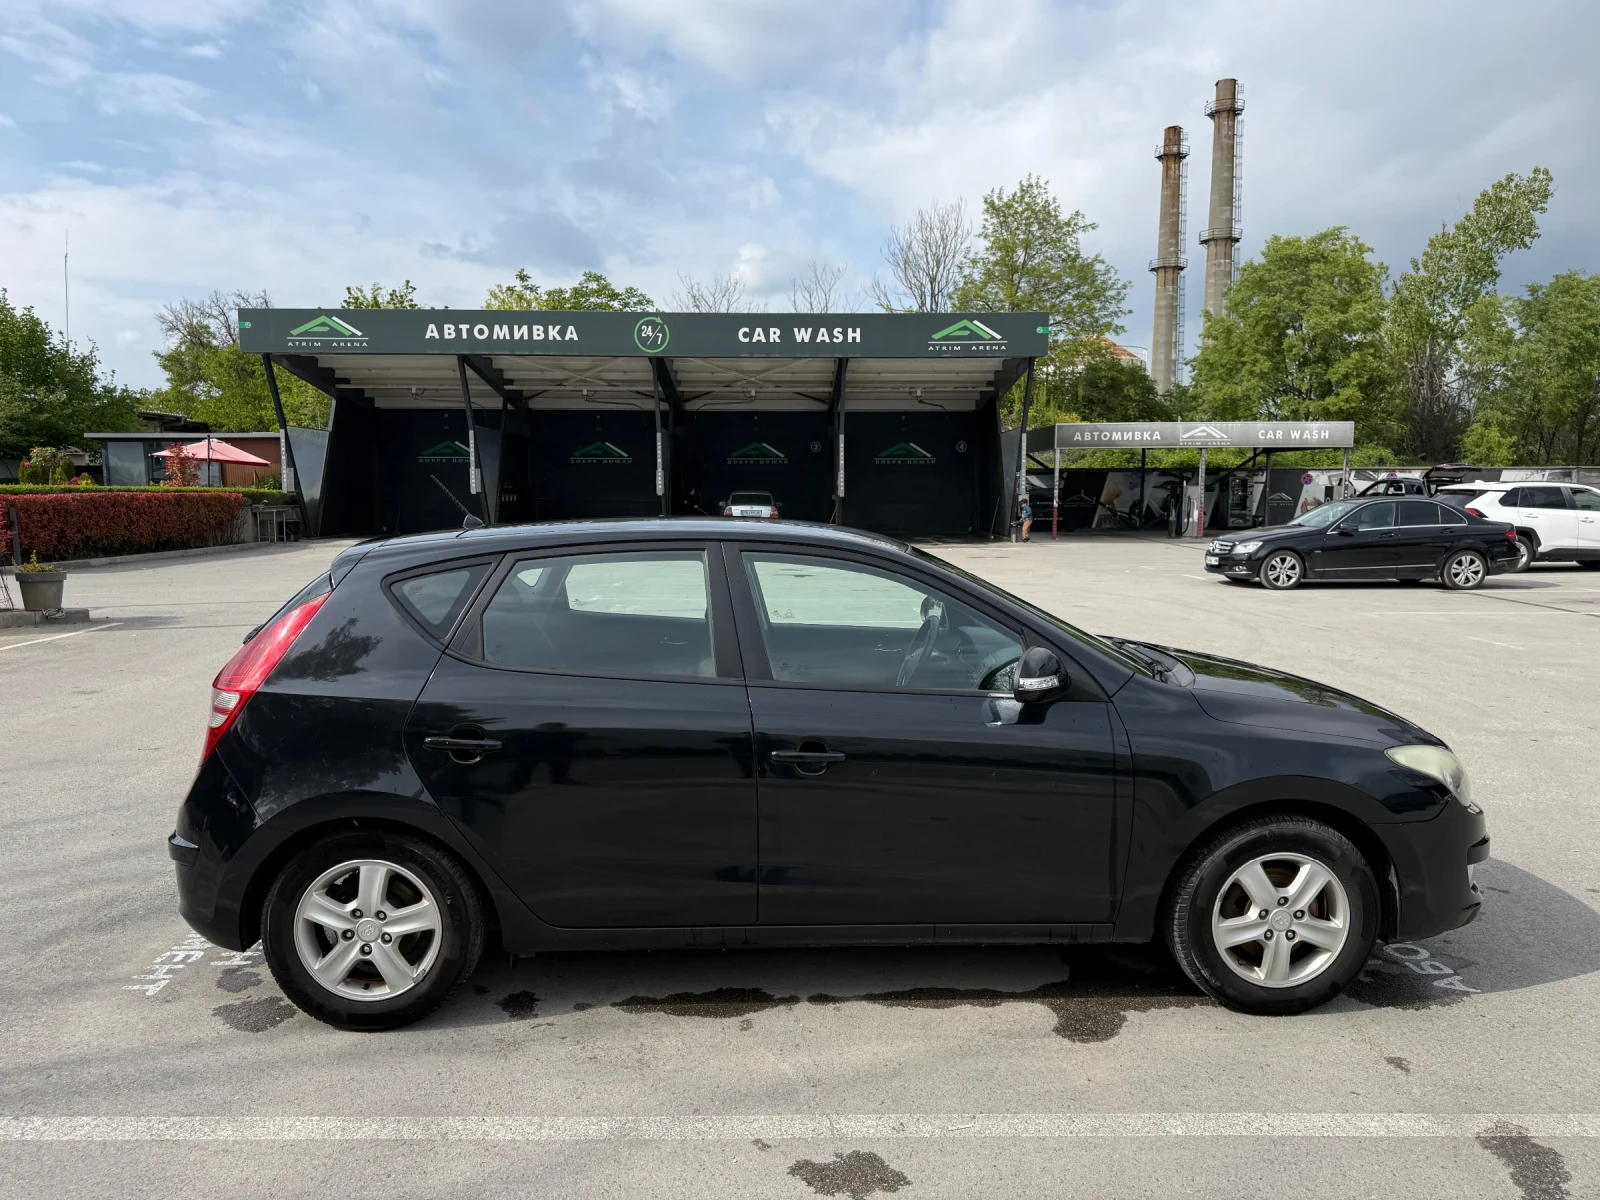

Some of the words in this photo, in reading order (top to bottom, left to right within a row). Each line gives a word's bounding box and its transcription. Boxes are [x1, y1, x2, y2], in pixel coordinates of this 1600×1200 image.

[425, 323, 579, 341] АВТОМИВКА
[641, 325, 662, 346] 24/7
[737, 327, 782, 343] CAR
[793, 327, 862, 343] WASH
[1073, 430, 1161, 442] АВТОМИВКА
[1257, 429, 1284, 440] CAR
[1290, 429, 1330, 440] WASH
